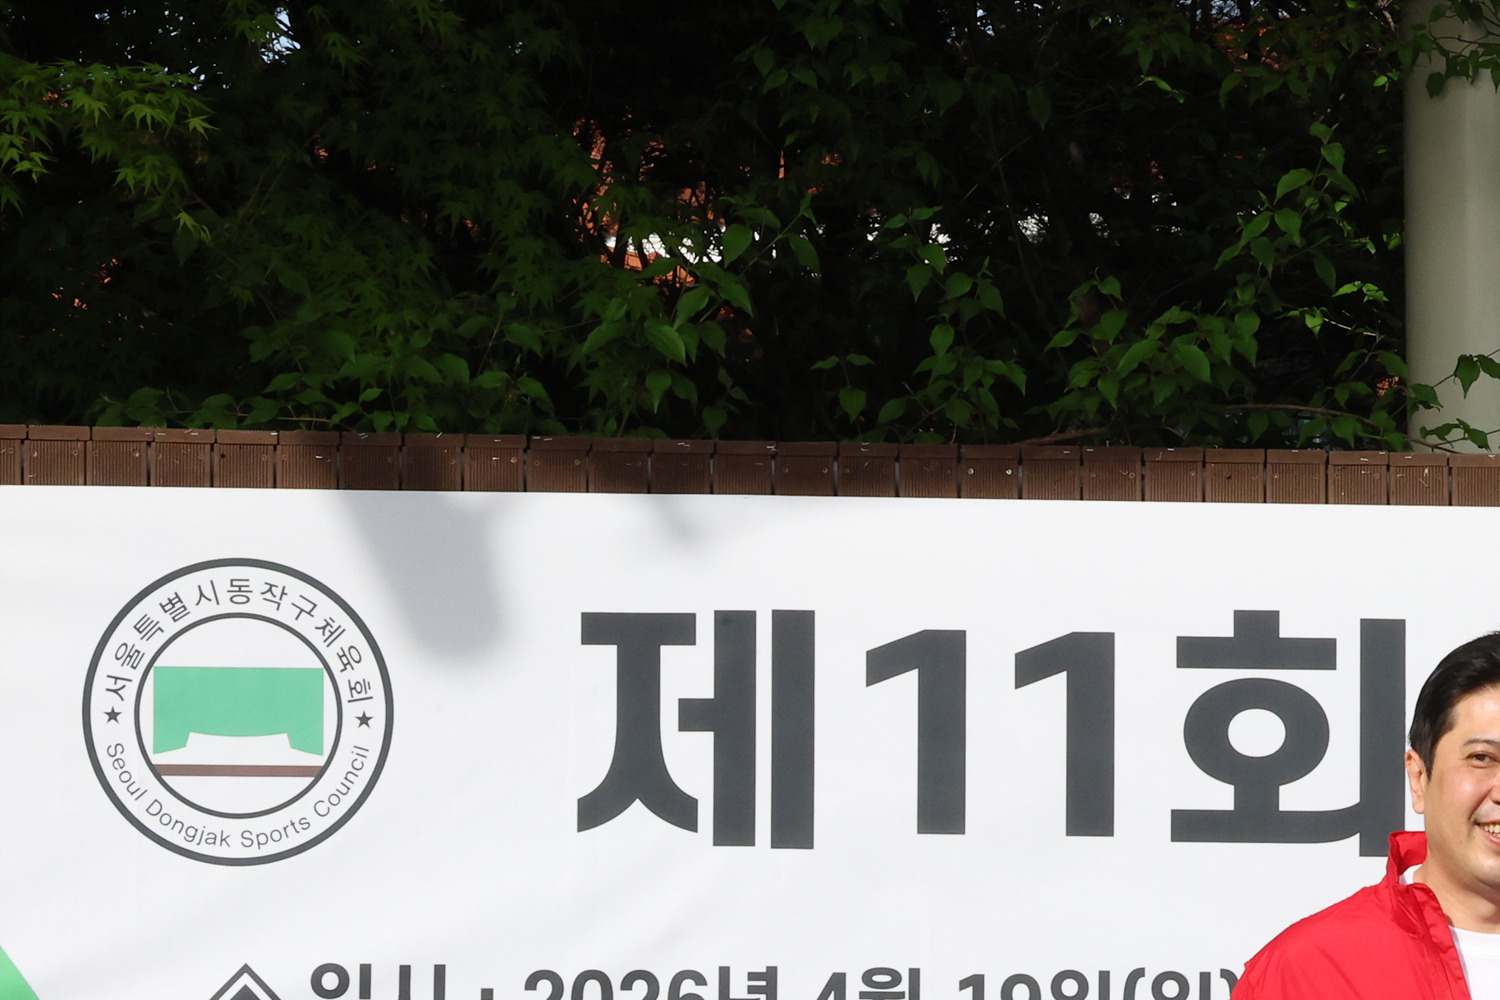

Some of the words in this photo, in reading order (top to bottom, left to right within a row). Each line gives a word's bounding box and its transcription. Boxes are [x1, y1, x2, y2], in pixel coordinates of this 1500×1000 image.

[105, 578, 374, 703] 서울특별시동작구체육회
[106, 742, 148, 801] Seoul
[145, 798, 231, 848] Dongjak
[240, 814, 311, 850] Sports
[313, 745, 370, 818] Council
[576, 609, 1407, 858] 제11회
